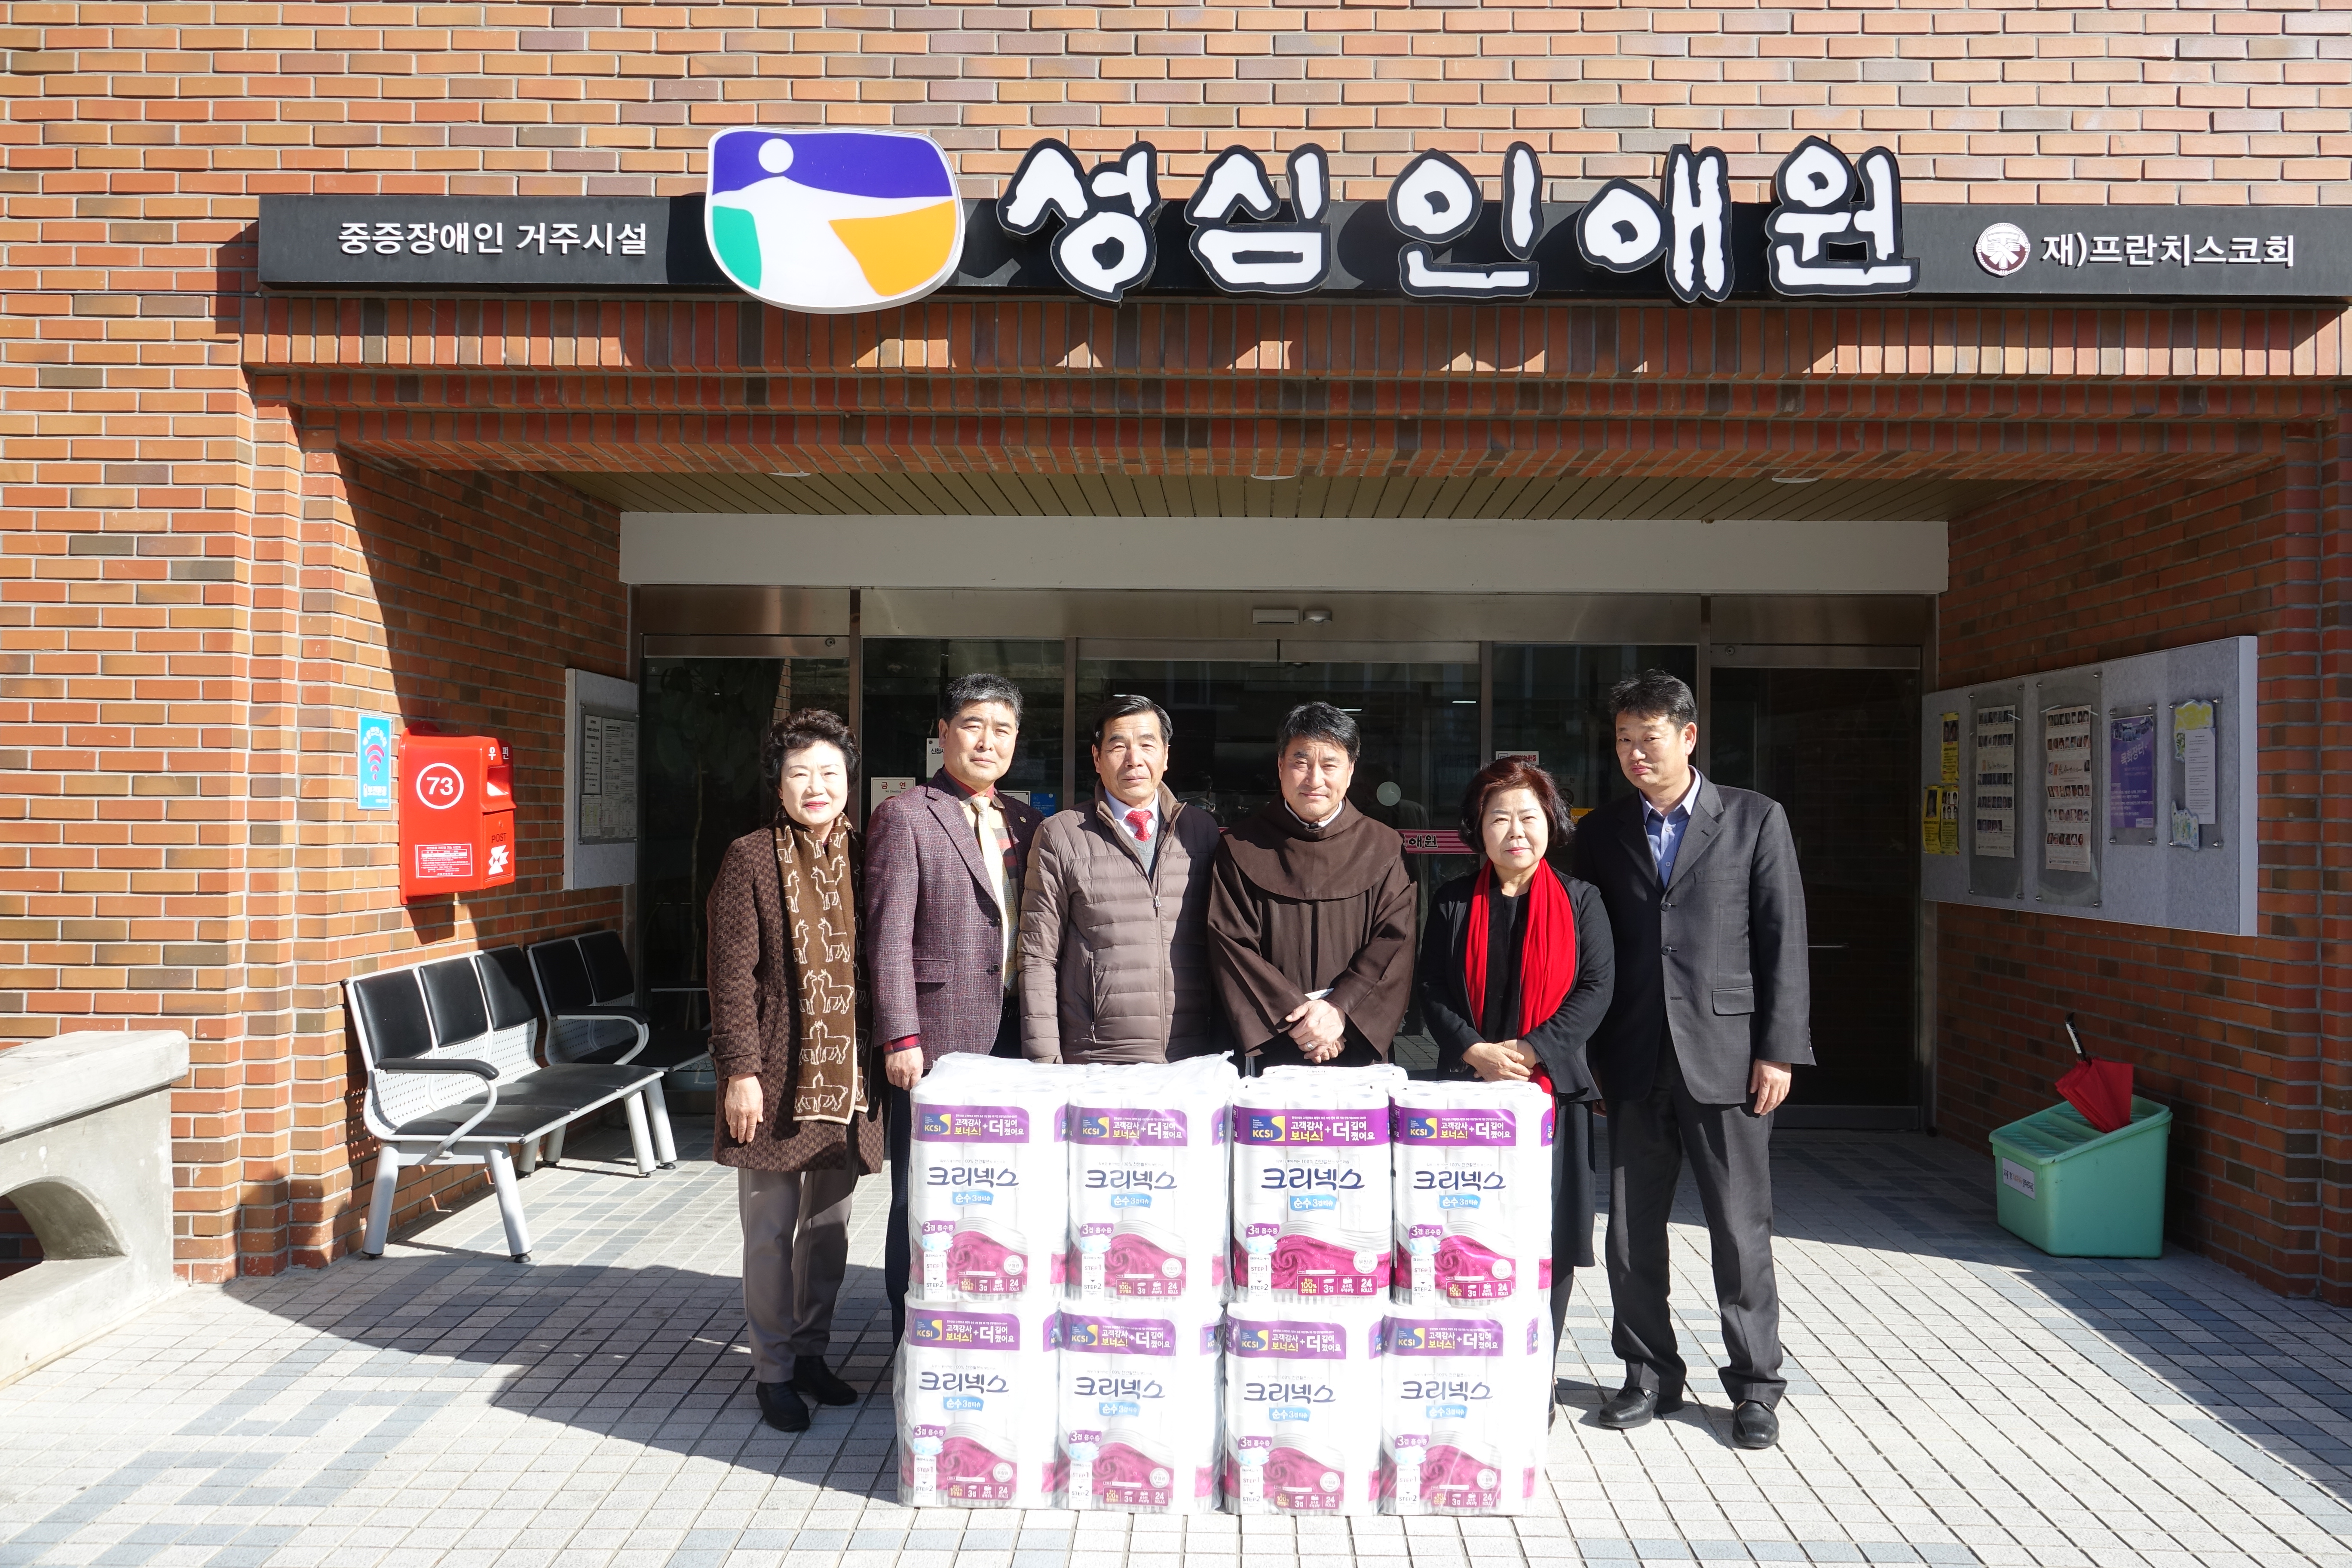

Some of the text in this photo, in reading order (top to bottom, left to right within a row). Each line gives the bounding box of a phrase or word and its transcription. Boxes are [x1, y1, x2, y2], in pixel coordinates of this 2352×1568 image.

[1004, 140, 1915, 301] 성심인애원
[338, 222, 646, 254] 중증장애인 거주시설
[2043, 232, 2294, 267] 재)프란치스코회
[426, 777, 453, 795] 73
[491, 833, 507, 843] POST
[955, 1118, 981, 1127] 고객감사
[989, 1119, 1003, 1136] 더
[1113, 1121, 1139, 1130] 고객감사
[1291, 1121, 1323, 1130] 고객감사
[1441, 1122, 1467, 1130] 고객감사
[954, 1127, 981, 1136] 보너스!
[1004, 1128, 1023, 1136] 졌어요
[1113, 1130, 1139, 1139] 보너스!
[1148, 1122, 1161, 1139] 더
[1253, 1130, 1273, 1138] KCSI
[1333, 1121, 1366, 1141] 더 길어
[1441, 1130, 1467, 1139] 보너스!
[1476, 1122, 1490, 1139] 더
[1290, 1131, 1323, 1142] 보너스!
[1351, 1131, 1375, 1141] 졌어요
[927, 1167, 1019, 1188] 크리넥스
[1085, 1169, 1177, 1191] 크리넥스
[1261, 1168, 1365, 1191] 크리넥스
[1414, 1170, 1506, 1191] 크리넥스
[956, 1193, 971, 1203] 순수
[1114, 1196, 1129, 1206] 순수
[1294, 1197, 1311, 1209] 순수
[1443, 1197, 1458, 1207] 순수
[924, 1222, 935, 1231] 3겹
[1082, 1225, 1093, 1234] 3겹
[1248, 1225, 1259, 1234] 3겹
[1411, 1226, 1423, 1236] 3겹
[1361, 1278, 1372, 1288] 24
[1323, 1284, 1334, 1293] 3겹
[946, 1324, 972, 1333] 고객감사
[1102, 1329, 1128, 1338] 고객감사
[946, 1332, 972, 1342] 보너스!
[980, 1325, 1007, 1343] 더 길어
[1136, 1330, 1163, 1348] 더 길어
[1272, 1334, 1298, 1342] 고객감사
[1429, 1332, 1455, 1340] 고객감사
[1102, 1337, 1128, 1348] 보너스!
[1307, 1334, 1320, 1352] 더
[1428, 1340, 1455, 1350] 보너스!
[1464, 1332, 1477, 1349] 더
[1272, 1342, 1298, 1352] 보너스!
[918, 1372, 1009, 1394] 크리넥스
[1074, 1376, 1165, 1400] 크리넥스
[1243, 1382, 1336, 1404] 크리넥스
[1400, 1381, 1493, 1401] 크리넥스
[946, 1398, 962, 1409] 순수
[1102, 1404, 1118, 1414] 순수
[1430, 1407, 1445, 1417] 순수
[1272, 1409, 1287, 1420] 순수
